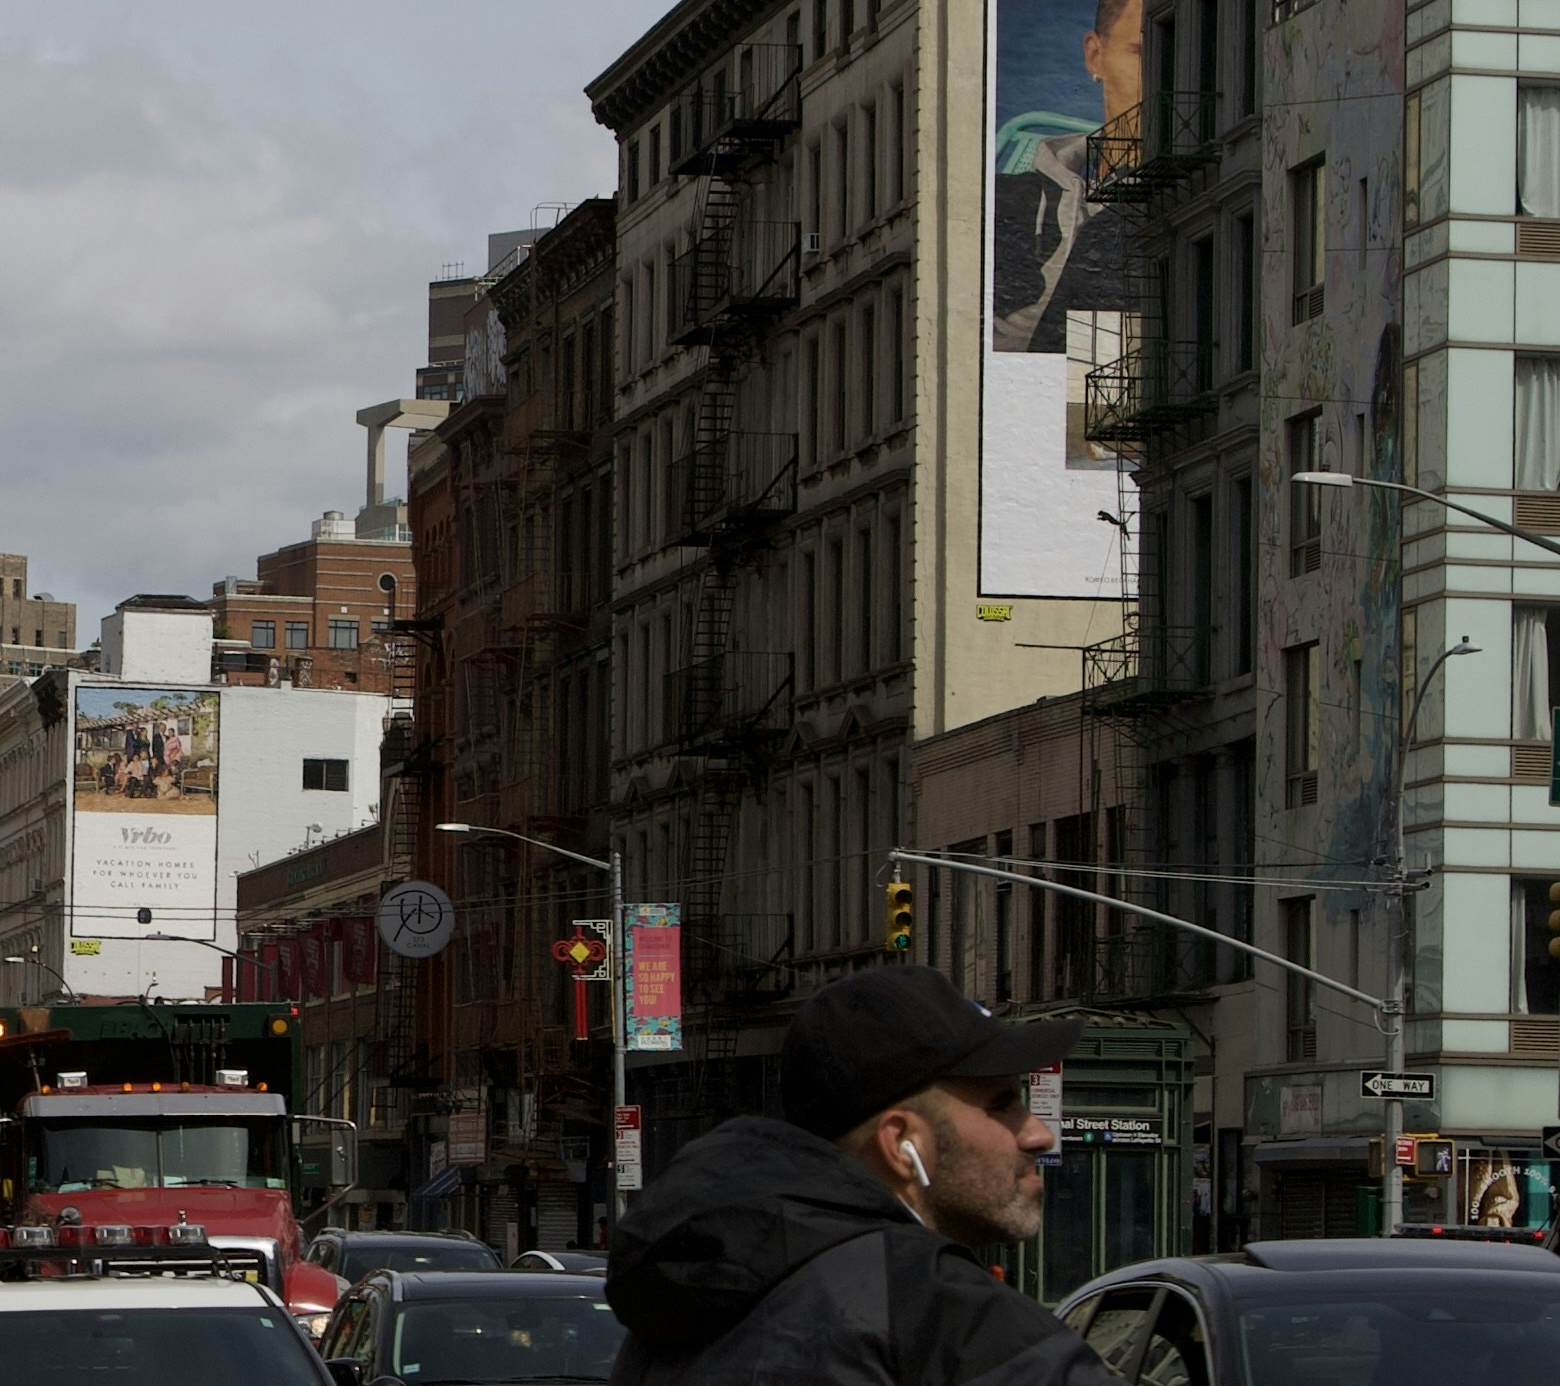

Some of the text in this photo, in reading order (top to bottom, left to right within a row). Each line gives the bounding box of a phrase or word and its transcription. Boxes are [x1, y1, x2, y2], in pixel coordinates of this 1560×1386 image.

[120, 826, 173, 844] Vrbo
[96, 859, 195, 869] VACATION HOMES
[92, 869, 114, 877] FOR
[119, 869, 171, 879] WHOEVER
[110, 880, 181, 890] CALL FAMILY
[638, 960, 668, 971] WE ARE
[650, 972, 676, 984] HAPPY
[651, 983, 665, 994] SEE
[1372, 1079, 1426, 1092] ONE WAY
[1076, 1118, 1150, 1132] Street Station
